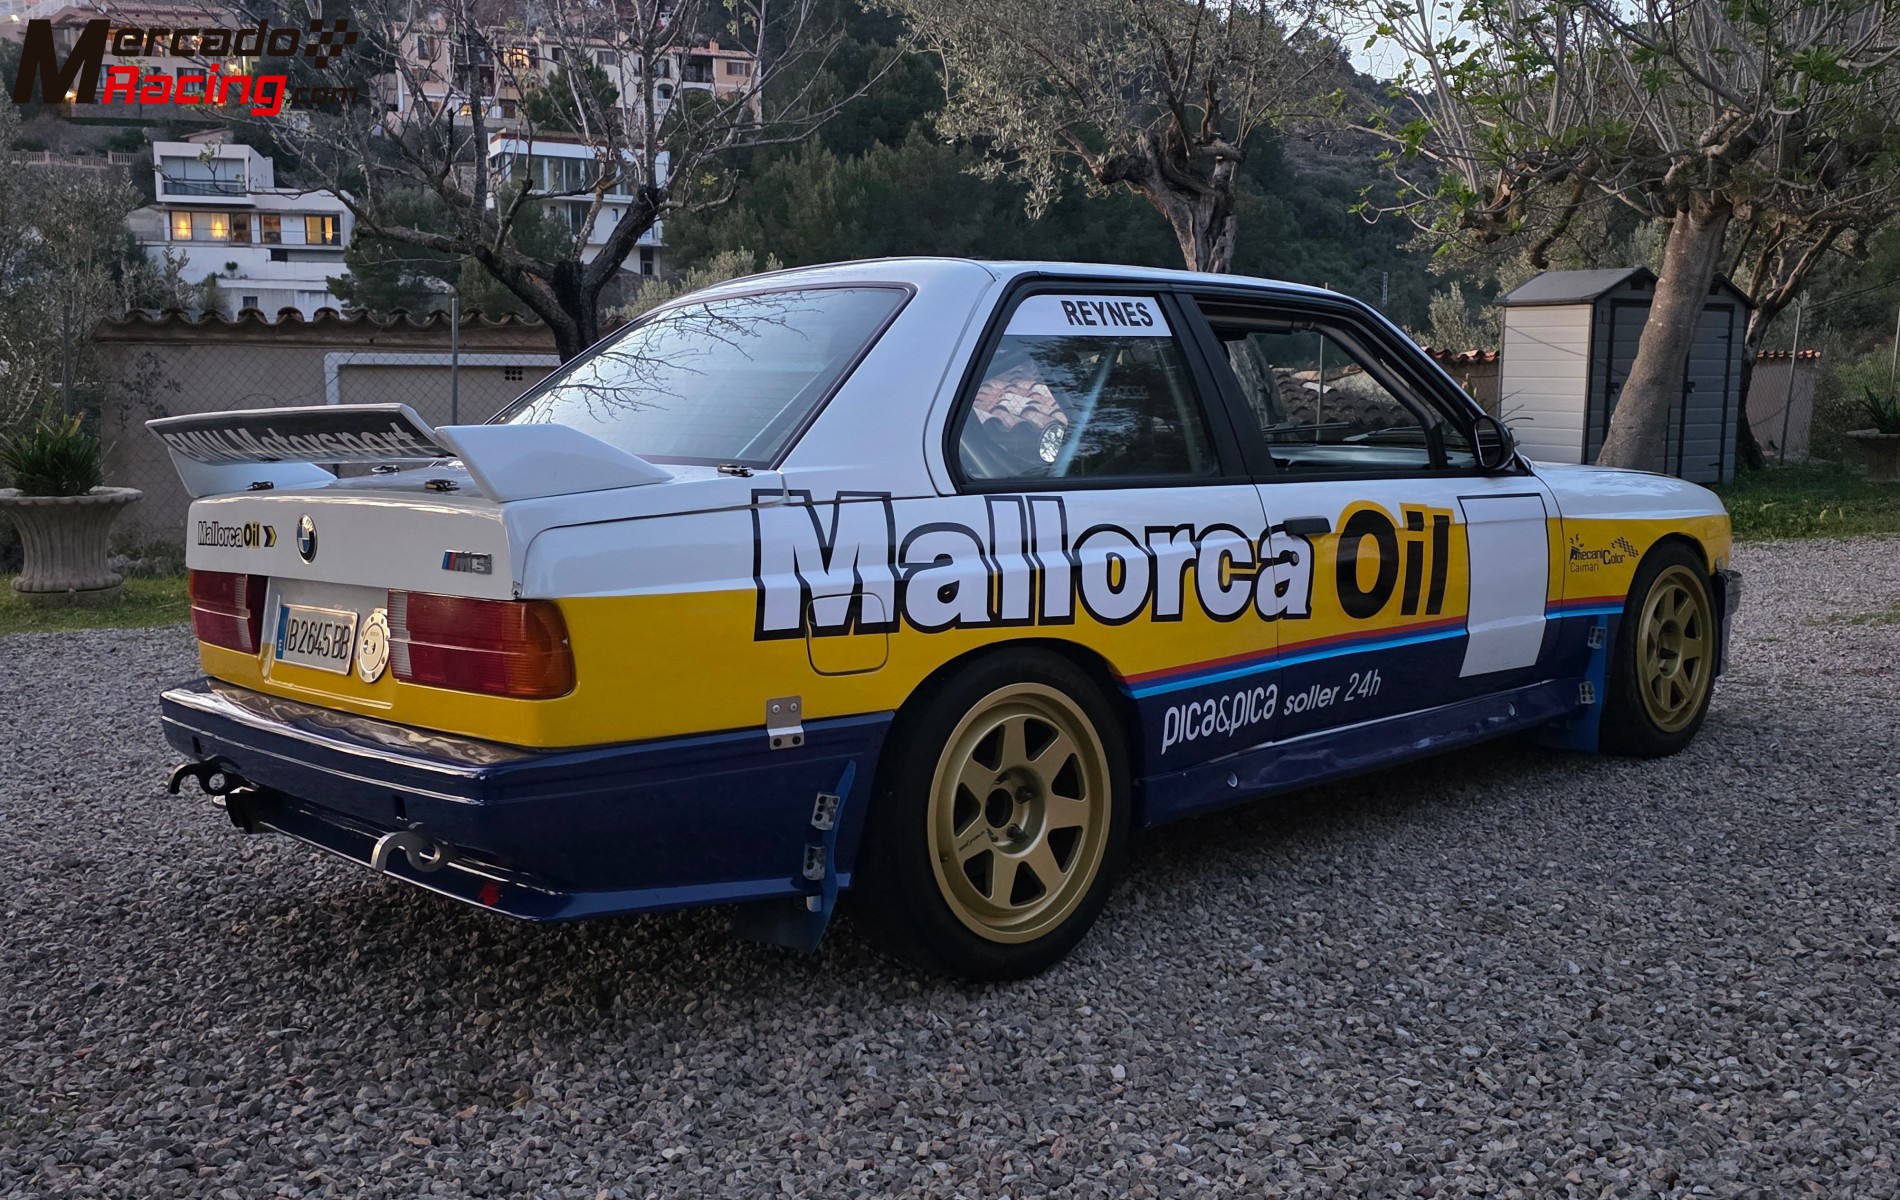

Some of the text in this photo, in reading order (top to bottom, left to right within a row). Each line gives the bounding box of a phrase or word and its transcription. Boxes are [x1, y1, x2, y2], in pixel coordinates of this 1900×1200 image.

[1060, 300, 1154, 327] REYNES
[162, 422, 427, 461] BMW Motorsport
[751, 489, 1454, 641] Mallorca Oil
[1160, 668, 1382, 755] pica&pica soller 24h
